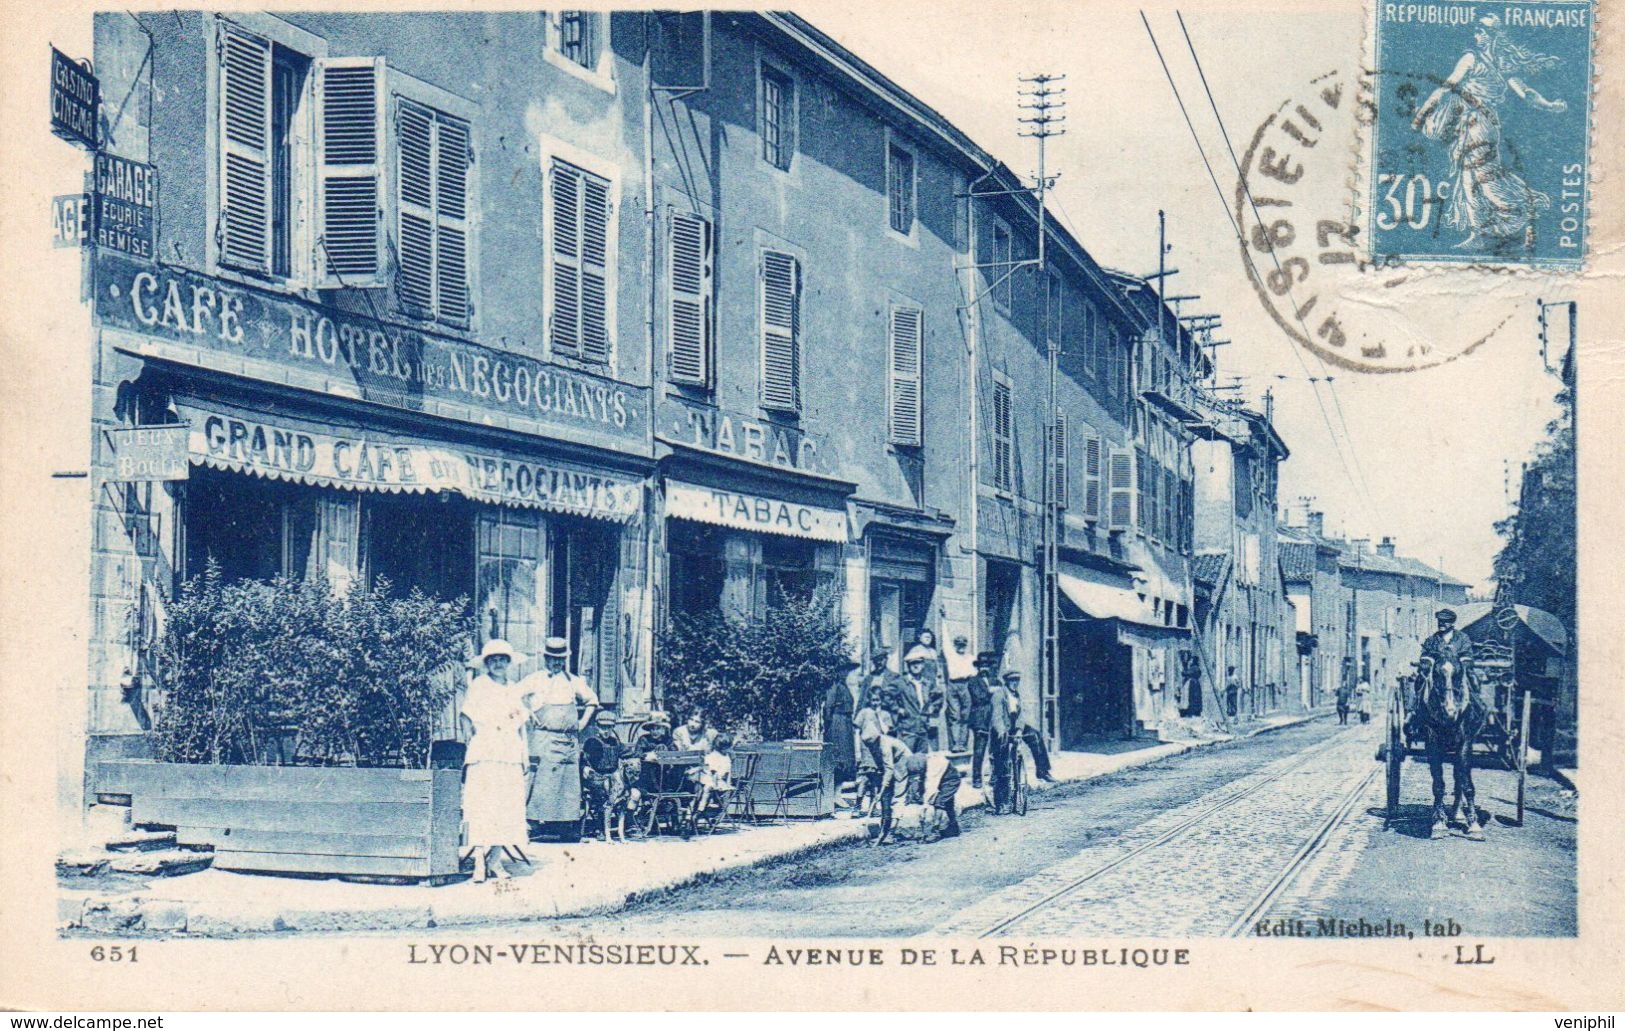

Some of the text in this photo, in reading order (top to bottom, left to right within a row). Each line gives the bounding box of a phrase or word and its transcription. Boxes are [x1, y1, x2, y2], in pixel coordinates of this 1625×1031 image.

[1505, 7, 1587, 28] FRANÇAISE
[55, 60, 93, 106] CASINO
[52, 89, 93, 140] CINEMA
[96, 155, 152, 208] GARAGE
[1560, 163, 1582, 248] POSTES
[98, 228, 150, 256] REMISE
[289, 311, 412, 381] HOTEL
[449, 351, 628, 428] NEGOCIANTS
[123, 430, 174, 447] JEUX
[204, 415, 316, 472] GRAND
[464, 454, 616, 510] NEGOCIANTS
[687, 410, 819, 471] TABAC
[713, 490, 812, 532] TABAC
